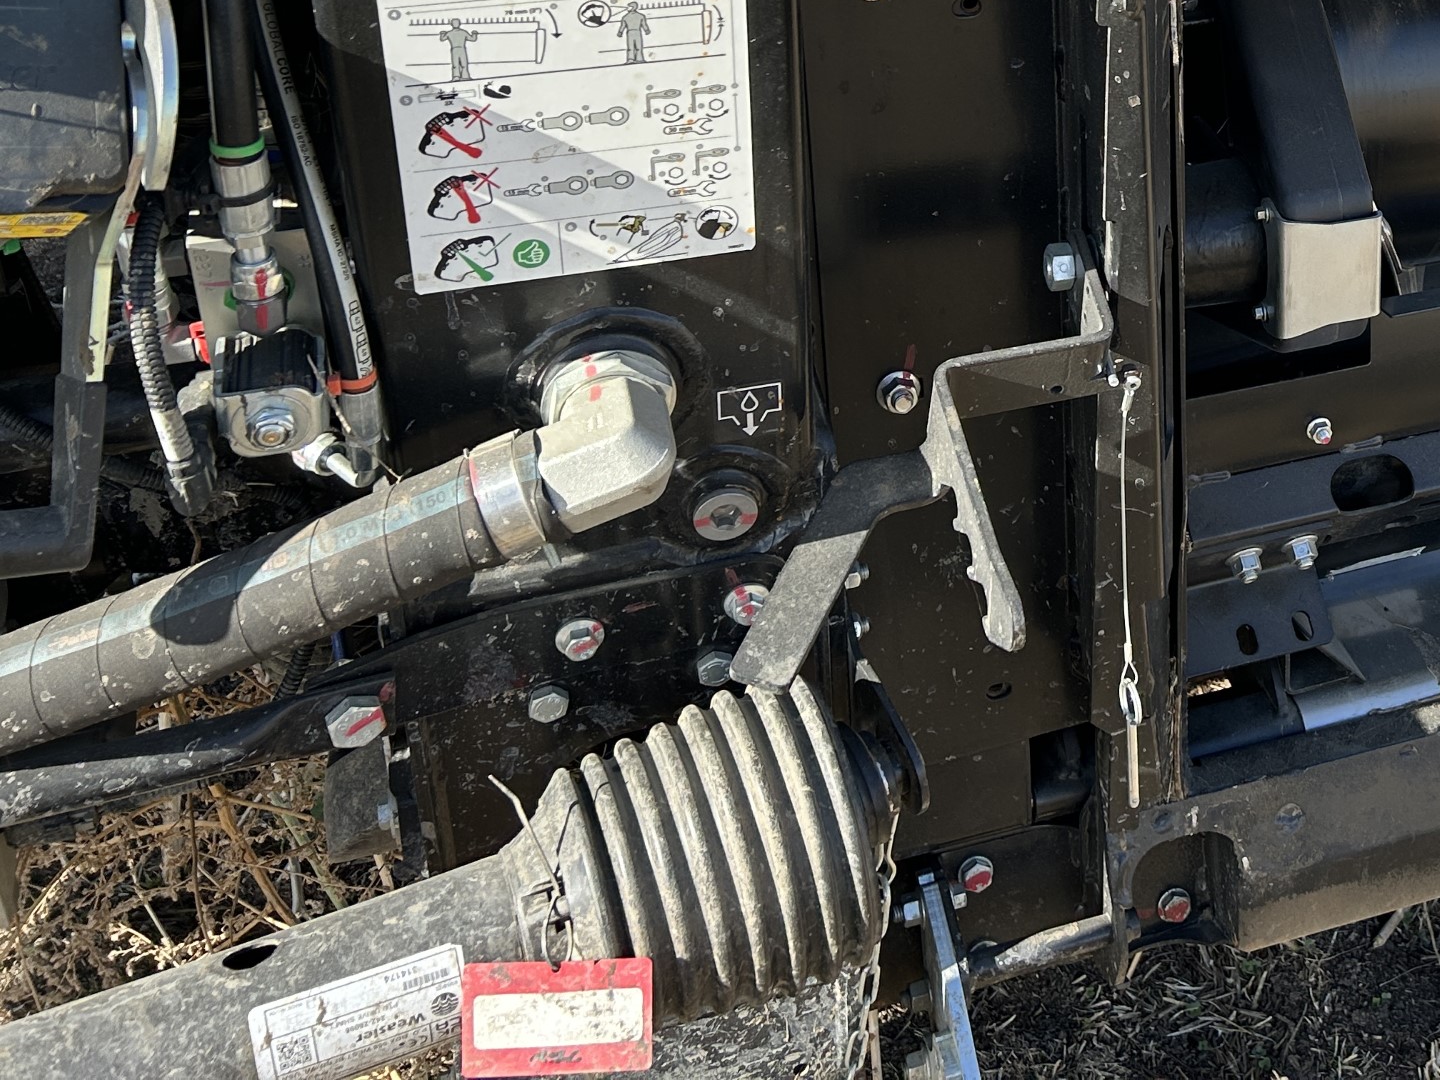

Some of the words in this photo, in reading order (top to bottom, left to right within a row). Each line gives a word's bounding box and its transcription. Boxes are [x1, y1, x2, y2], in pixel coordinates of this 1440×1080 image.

[263, 2, 294, 95] GLOBALCORE
[290, 115, 300, 130] ISO
[355, 1013, 425, 1042] Weasler
